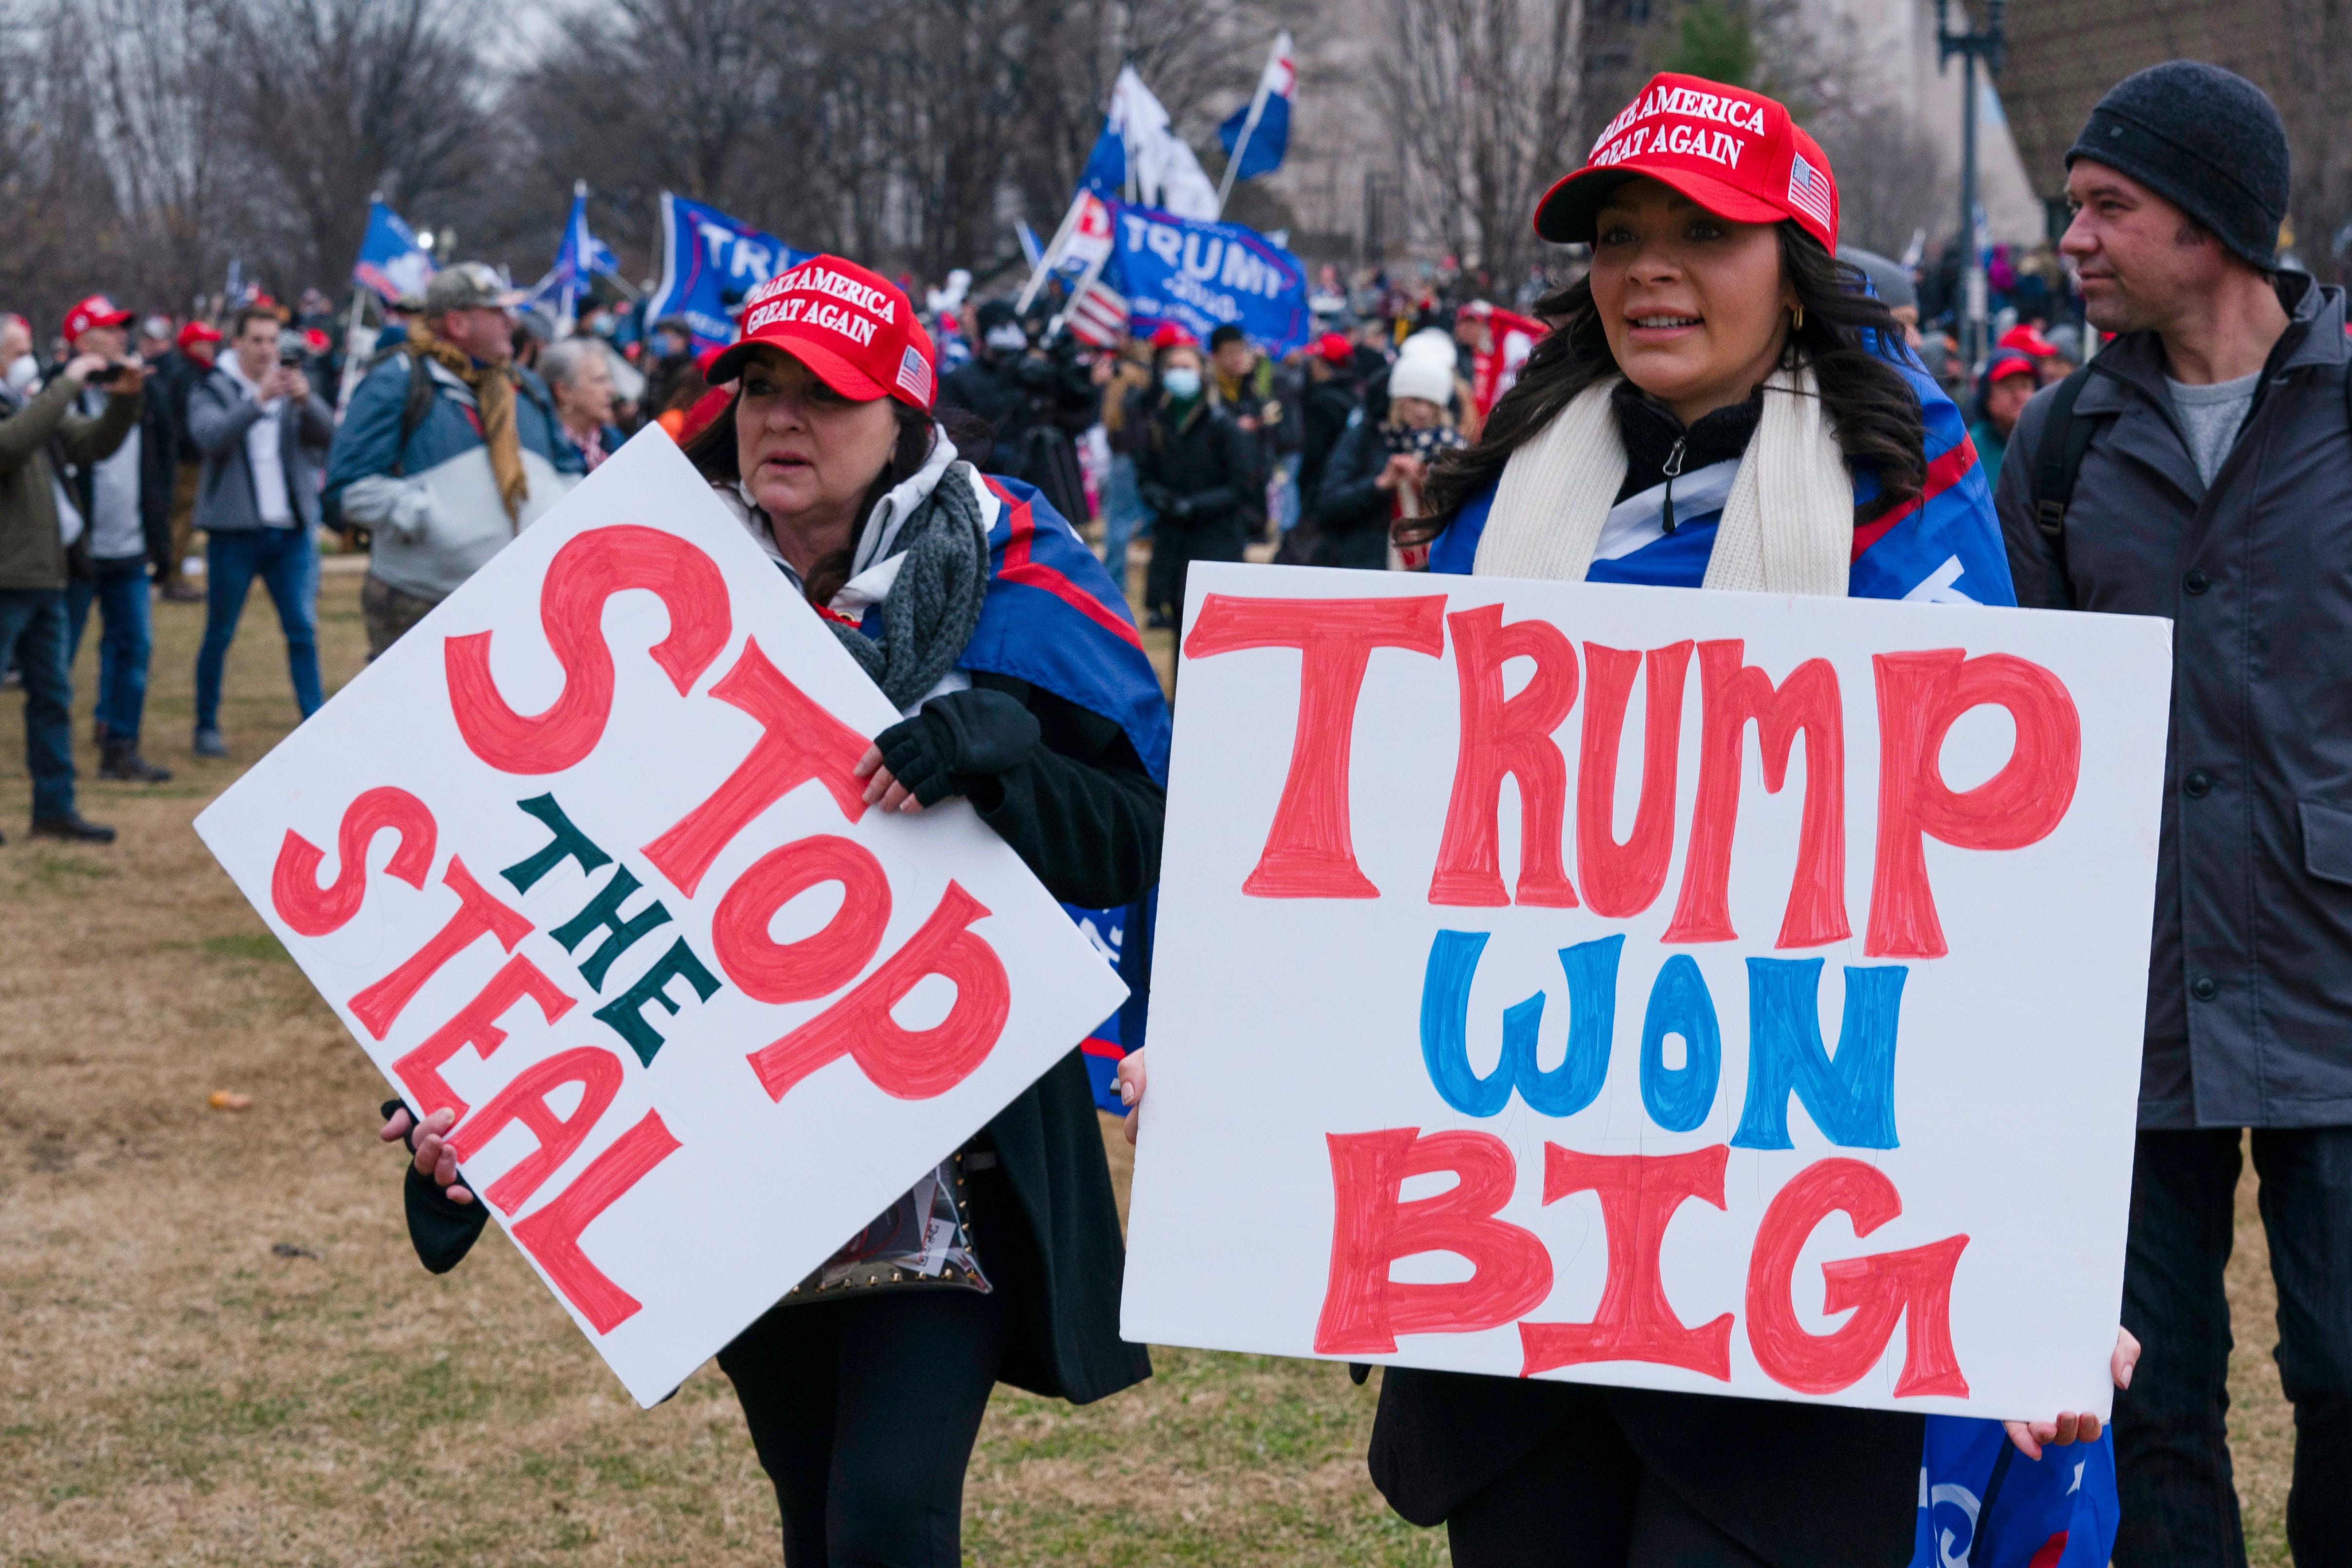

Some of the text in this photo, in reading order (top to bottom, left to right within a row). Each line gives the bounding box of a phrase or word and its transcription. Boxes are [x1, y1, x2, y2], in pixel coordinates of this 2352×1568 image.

[1594, 124, 1745, 170] REAT AGAIN
[1637, 85, 1765, 137] AMERICA
[746, 298, 806, 335] GREAT
[801, 300, 878, 348] AGAIN
[793, 267, 896, 325] AMERICA
[444, 525, 1010, 1103] STOP
[1184, 593, 2081, 959] TRUMP
[500, 793, 722, 1068] THE
[1419, 929, 1909, 1151] WON
[272, 786, 683, 1335] STEAL
[1313, 1127, 1970, 1399] BIG
